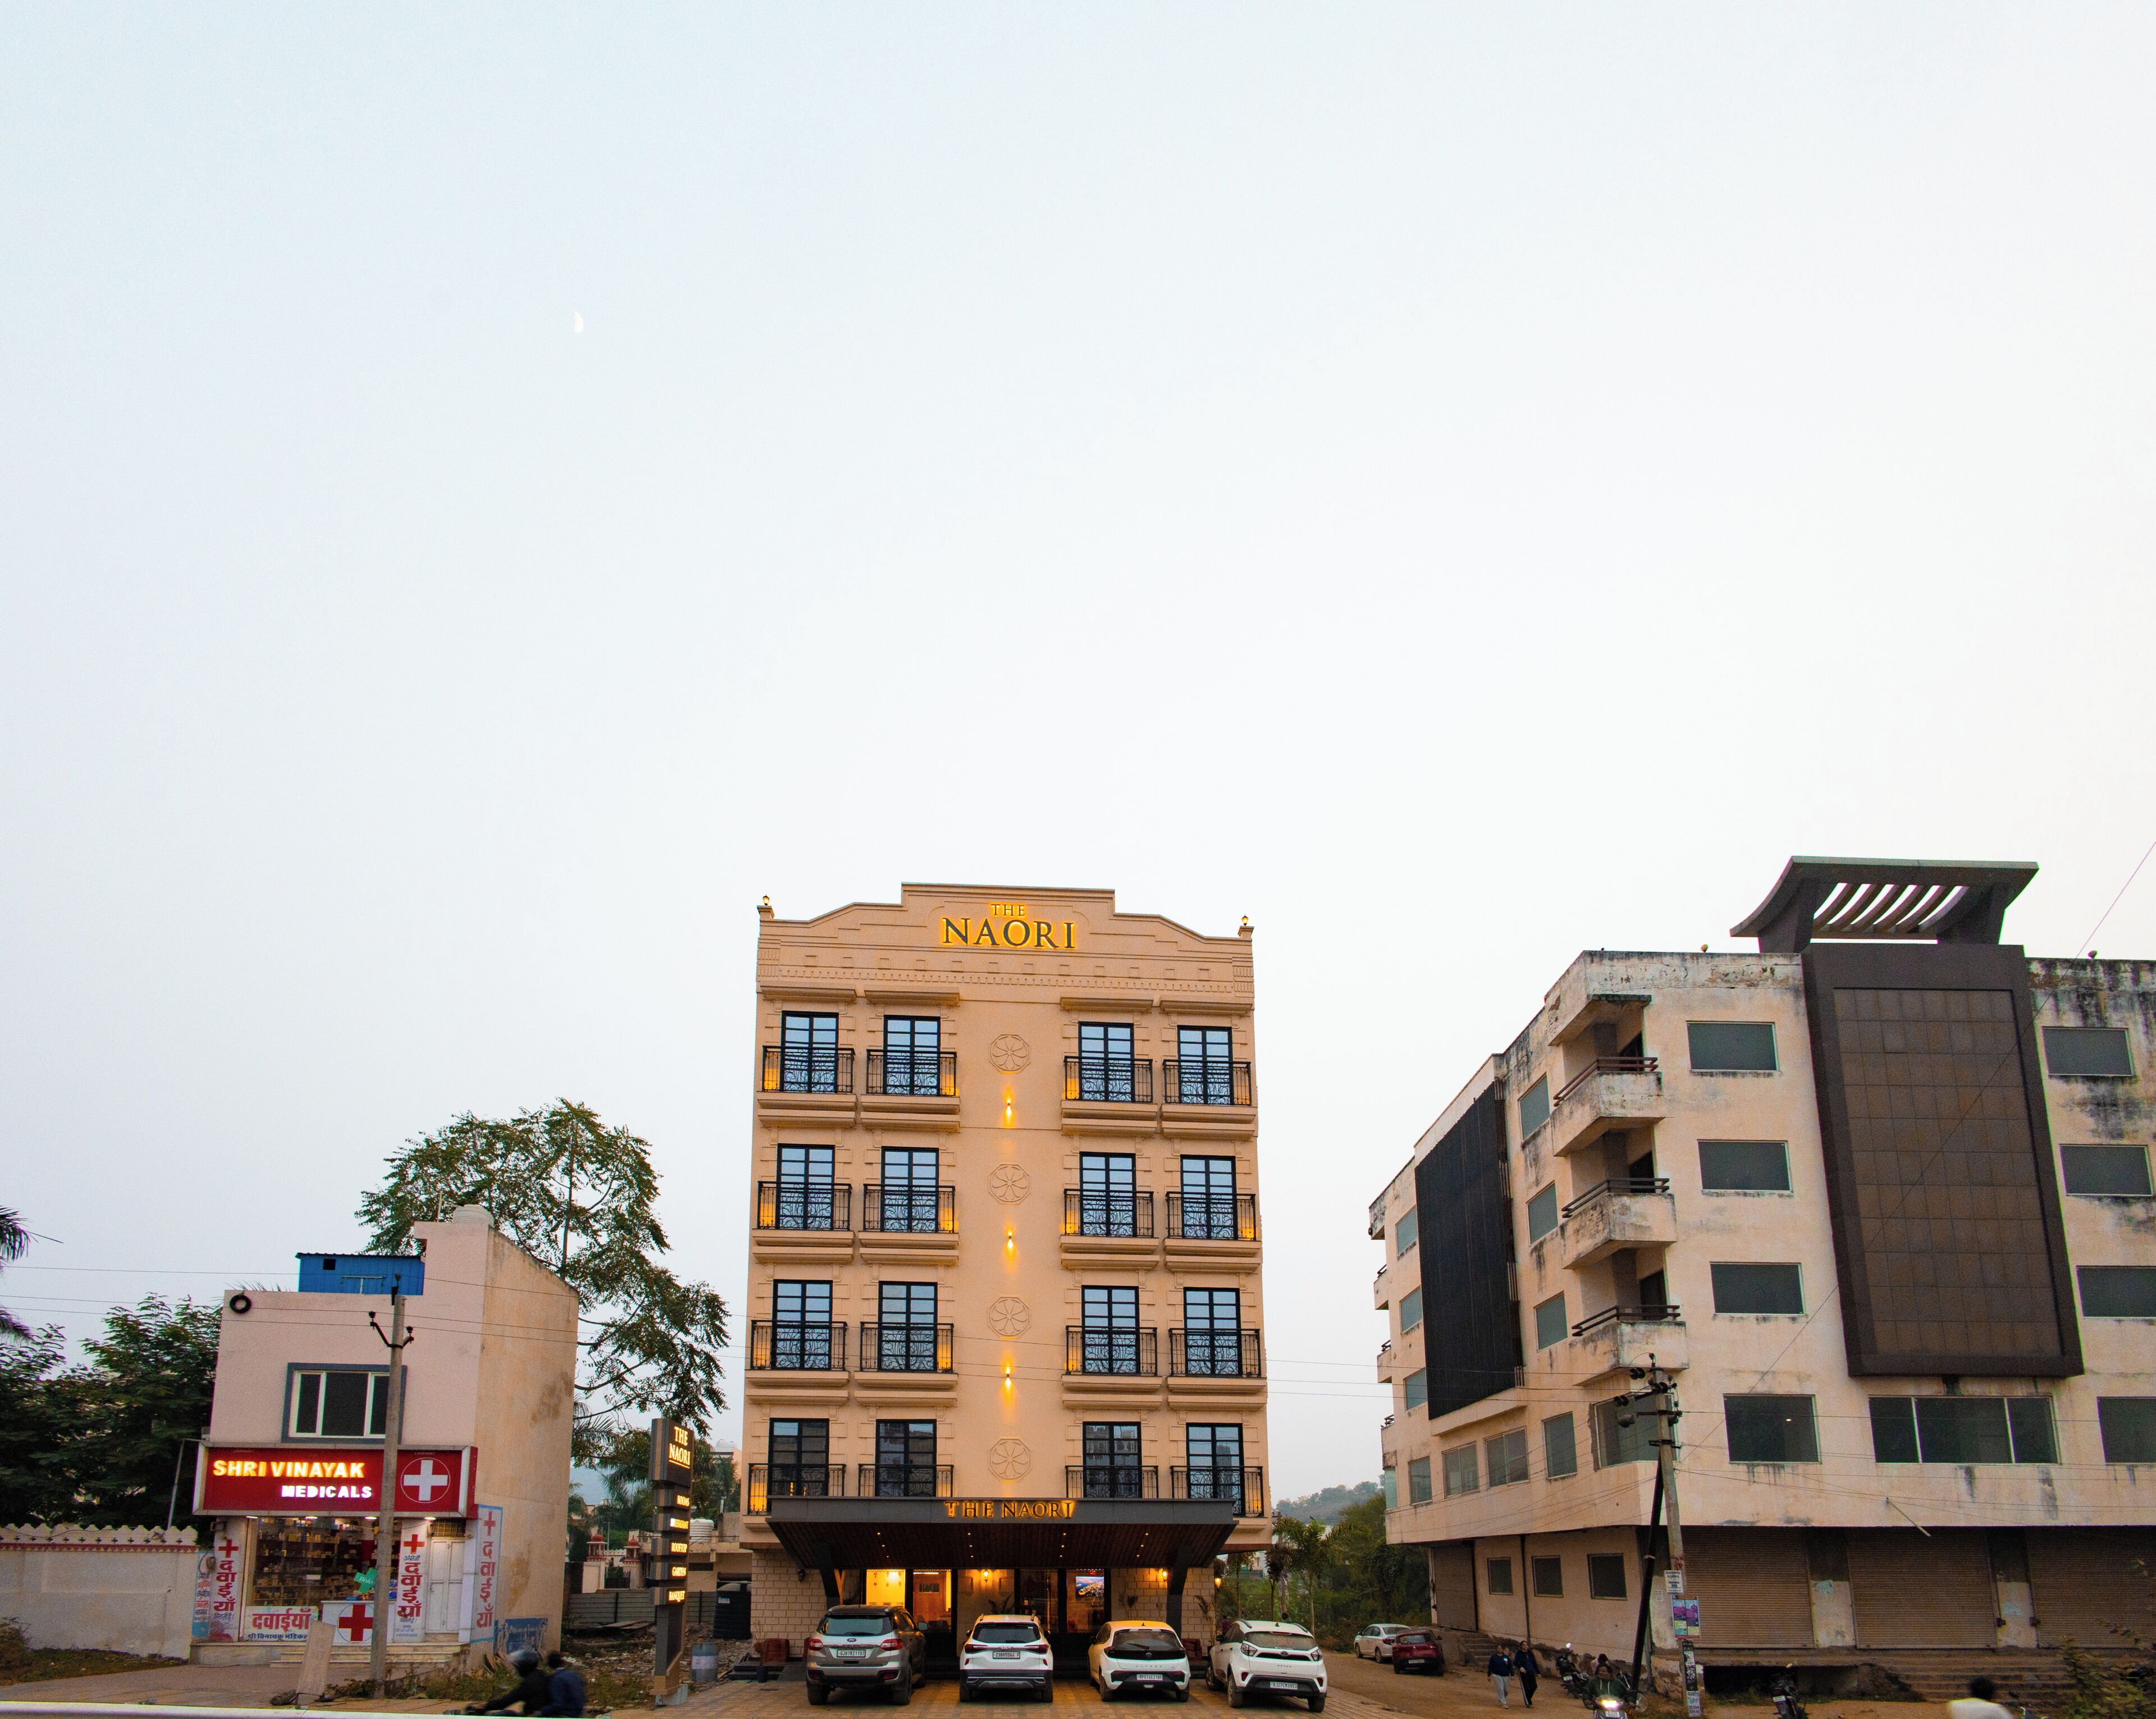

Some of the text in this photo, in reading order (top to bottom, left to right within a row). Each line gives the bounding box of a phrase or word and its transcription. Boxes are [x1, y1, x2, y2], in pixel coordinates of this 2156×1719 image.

[990, 904, 1025, 917] THE
[942, 917, 1075, 949] NAORI
[674, 1426, 688, 1446] THE
[669, 1443, 691, 1466] NAORI
[213, 1460, 366, 1479] SHRI VINAYAK
[281, 1485, 372, 1498] MEDICALS
[677, 1495, 690, 1507] ROOMS
[944, 1501, 1072, 1519] THE NAORI
[671, 1543, 688, 1553] ROOFTOP
[672, 1566, 687, 1577] GARDEN
[359, 1576, 374, 1585] Bisler
[669, 1590, 686, 1602] BANQUET
